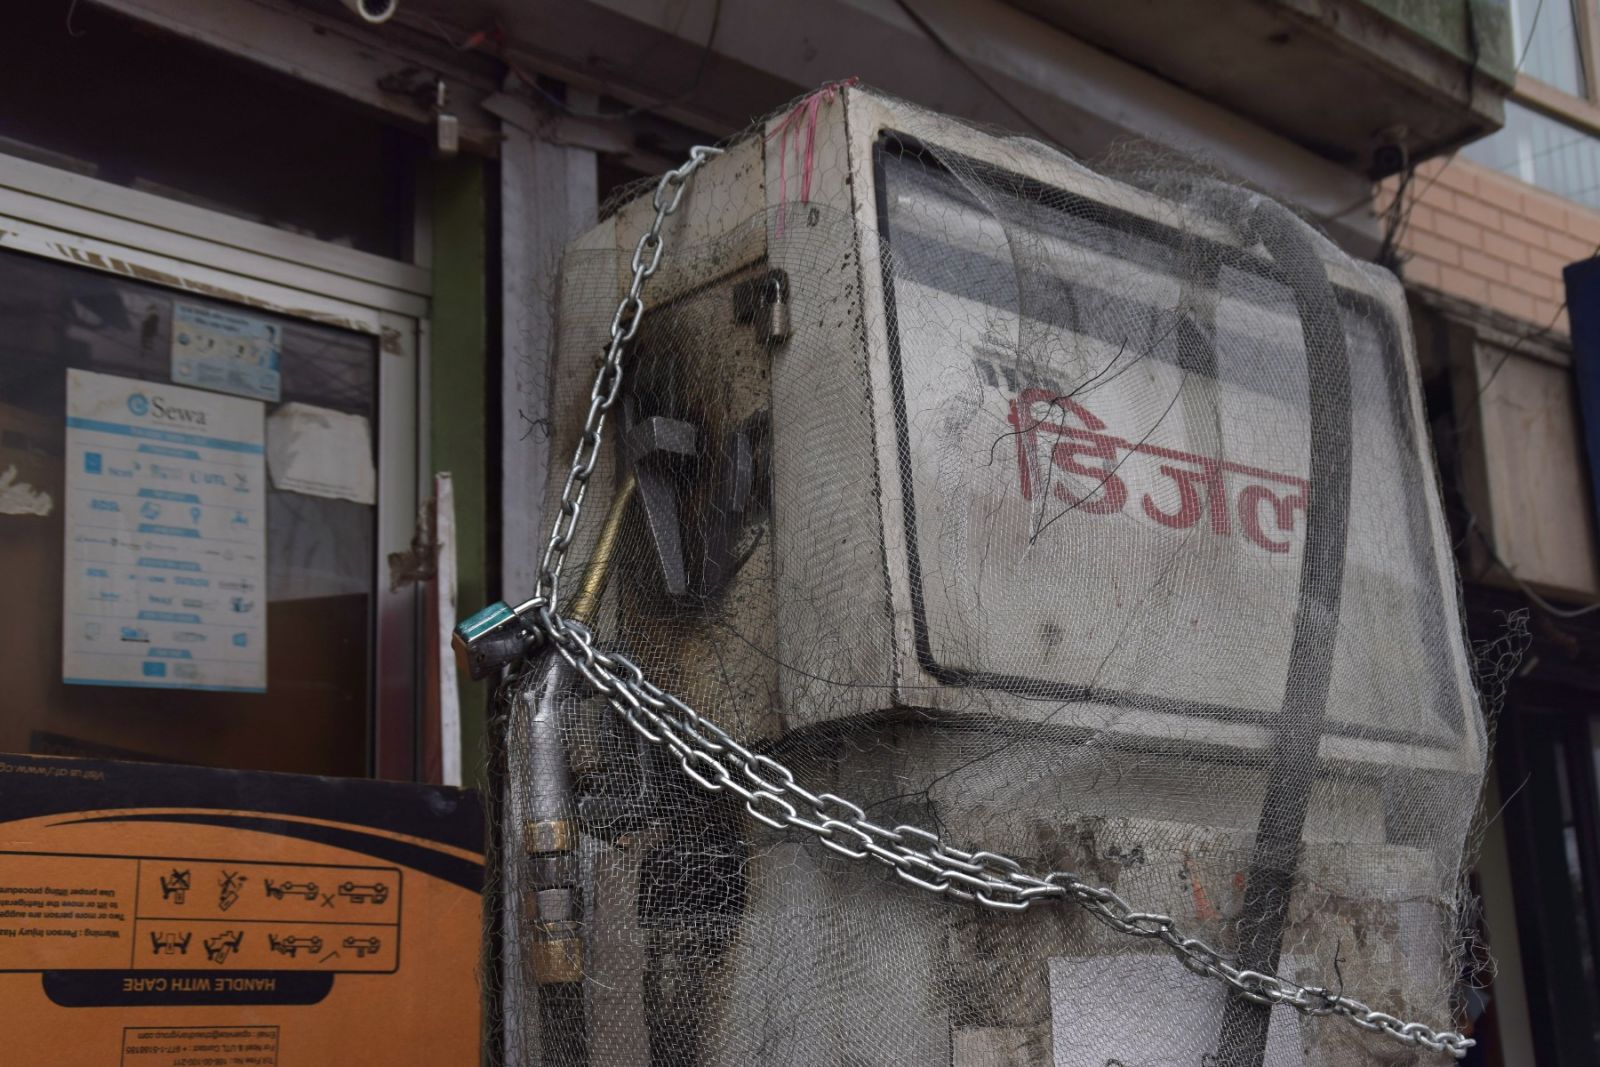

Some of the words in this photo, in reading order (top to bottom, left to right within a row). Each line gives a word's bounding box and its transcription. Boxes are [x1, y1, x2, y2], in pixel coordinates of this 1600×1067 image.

[18, 928, 44, 938] Injury
[46, 929, 77, 938] Person
[122, 978, 168, 991] CARE
[171, 978, 211, 991] WITH
[215, 978, 276, 991] HANDLE
